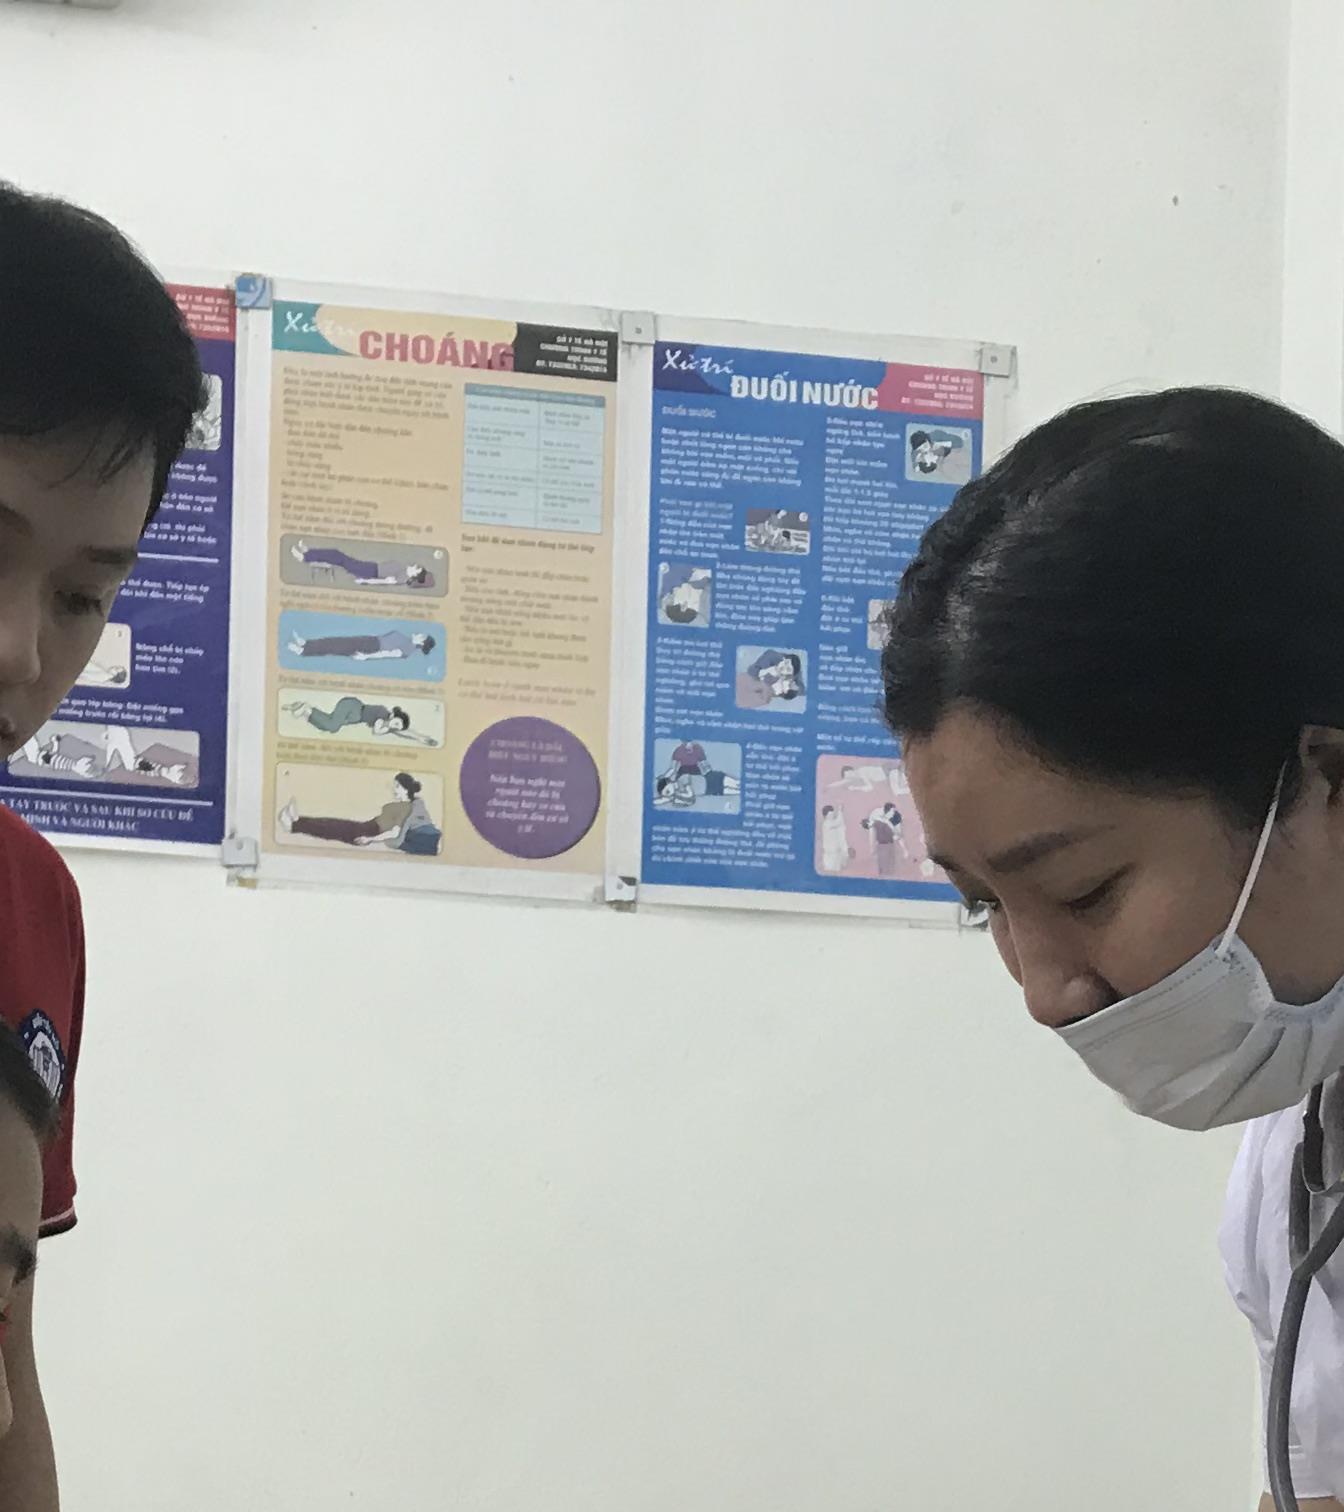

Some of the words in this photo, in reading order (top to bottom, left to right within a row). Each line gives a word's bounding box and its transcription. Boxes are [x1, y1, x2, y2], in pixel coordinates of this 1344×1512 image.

[359, 331, 514, 372] CHOÁNG
[730, 371, 798, 403] ĐUỐI
[803, 379, 879, 410] NƯỚC
